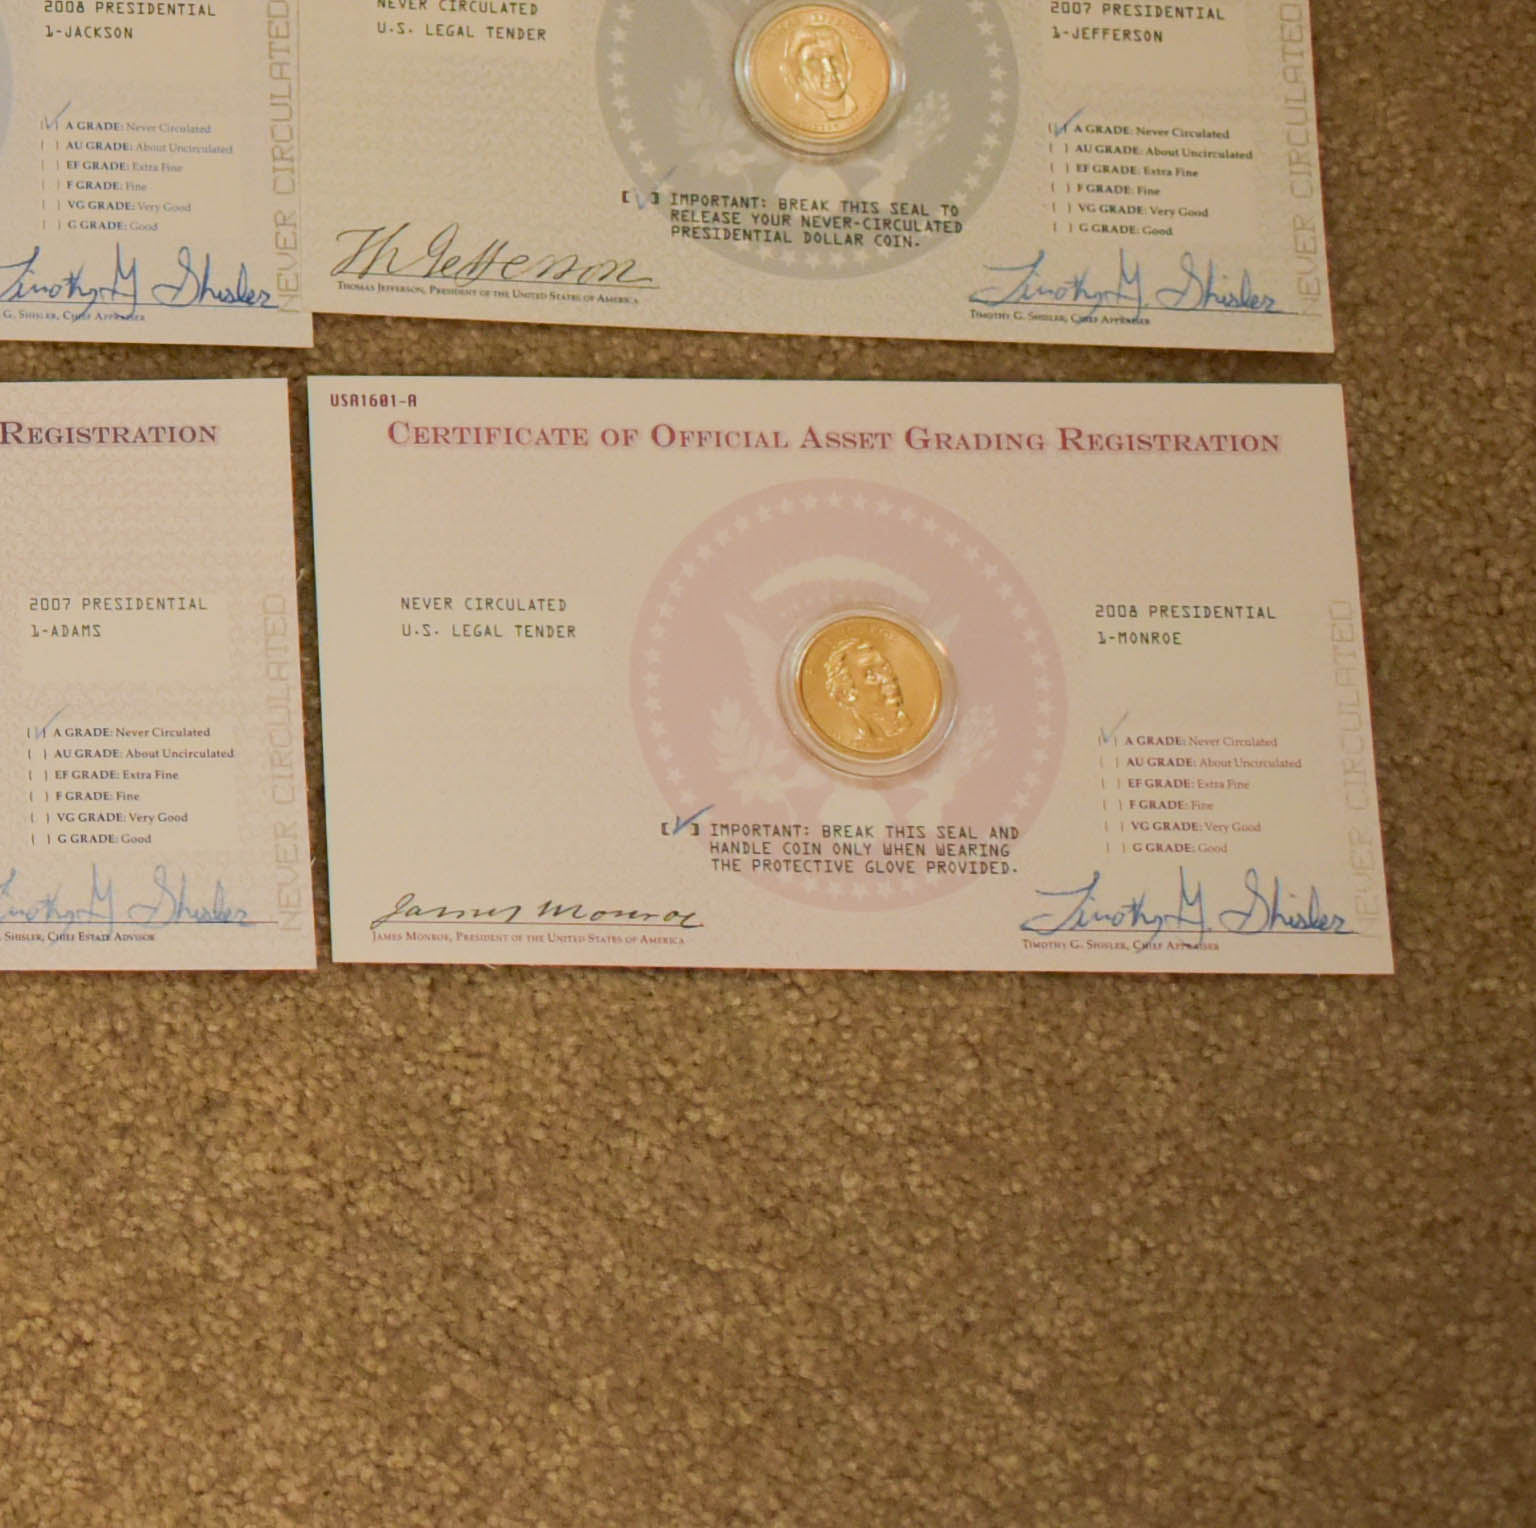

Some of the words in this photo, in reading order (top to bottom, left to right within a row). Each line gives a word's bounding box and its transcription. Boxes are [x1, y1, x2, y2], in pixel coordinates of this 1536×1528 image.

[43, 0, 85, 14] 2008
[95, 0, 216, 17] PRESIDENTIAL
[1050, 0, 1092, 15] 2007
[1101, 2, 1225, 21] PRESIDENTIAL
[45, 24, 133, 40] 1-JACKSON
[1052, 25, 1164, 44] 1-JEFFERSON
[387, 420, 589, 448] CERTIFICATE
[600, 428, 640, 447] OF
[650, 423, 789, 449] OFFICIAL
[799, 425, 893, 450] ASSET
[903, 425, 1045, 451] GRADING
[1057, 427, 1279, 453] REGISTRATION
[28, 597, 71, 612] 2007
[81, 596, 208, 611] PRESIDENTIAL
[1095, 603, 1138, 619] 2008
[1148, 604, 1277, 620] PRESIDENTIAL
[31, 623, 102, 638] 1-ADAMS
[401, 623, 439, 638] U.S.
[452, 623, 503, 638] LEGAL
[513, 623, 576, 639] TENDER
[1097, 630, 1183, 646] 1-MONROE
